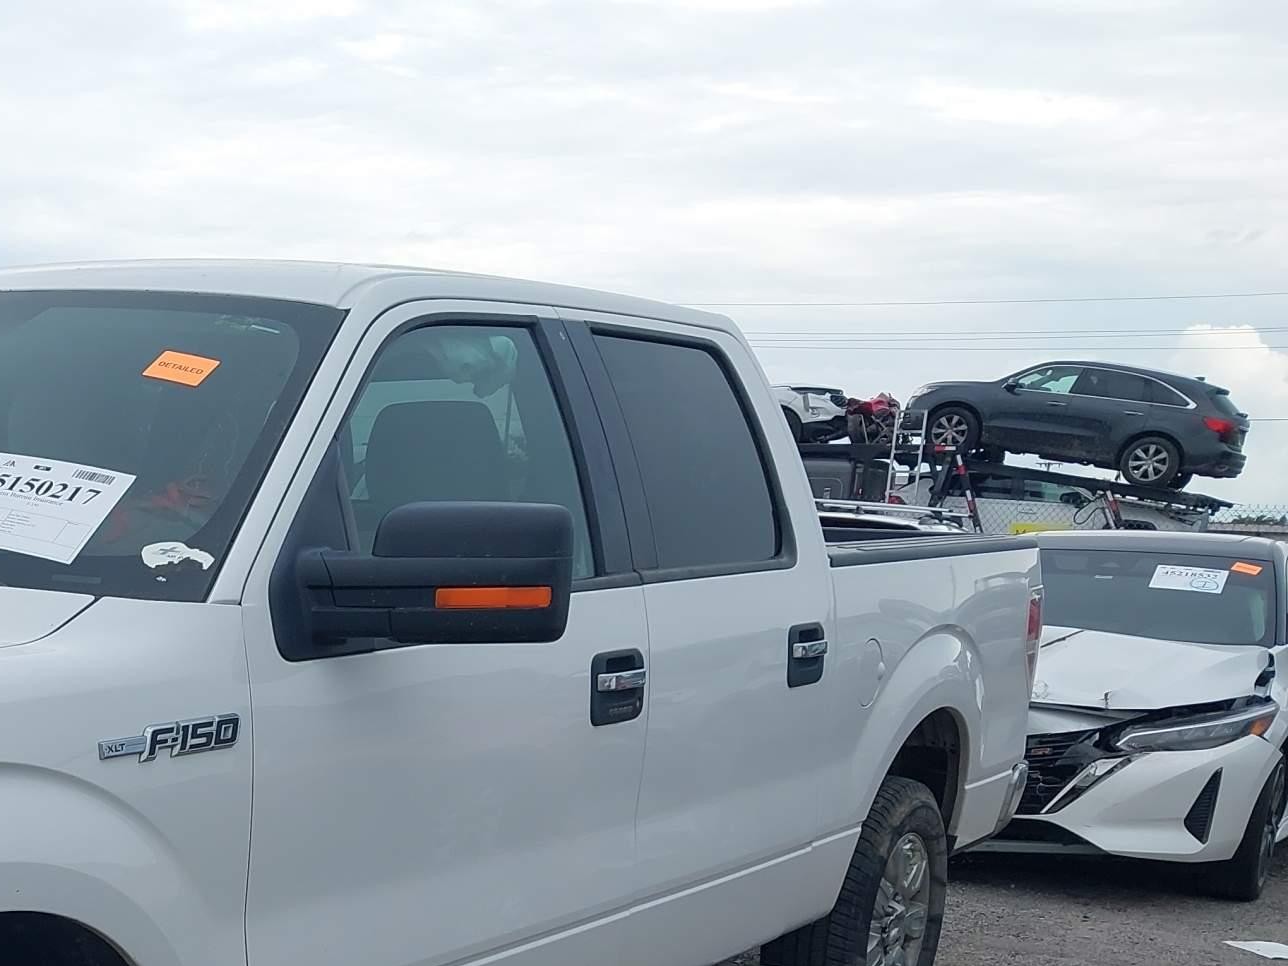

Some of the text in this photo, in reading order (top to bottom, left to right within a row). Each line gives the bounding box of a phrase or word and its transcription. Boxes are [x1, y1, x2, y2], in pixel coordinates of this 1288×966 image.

[158, 361, 204, 375] DETAILED
[106, 713, 241, 763] XLT F-150
